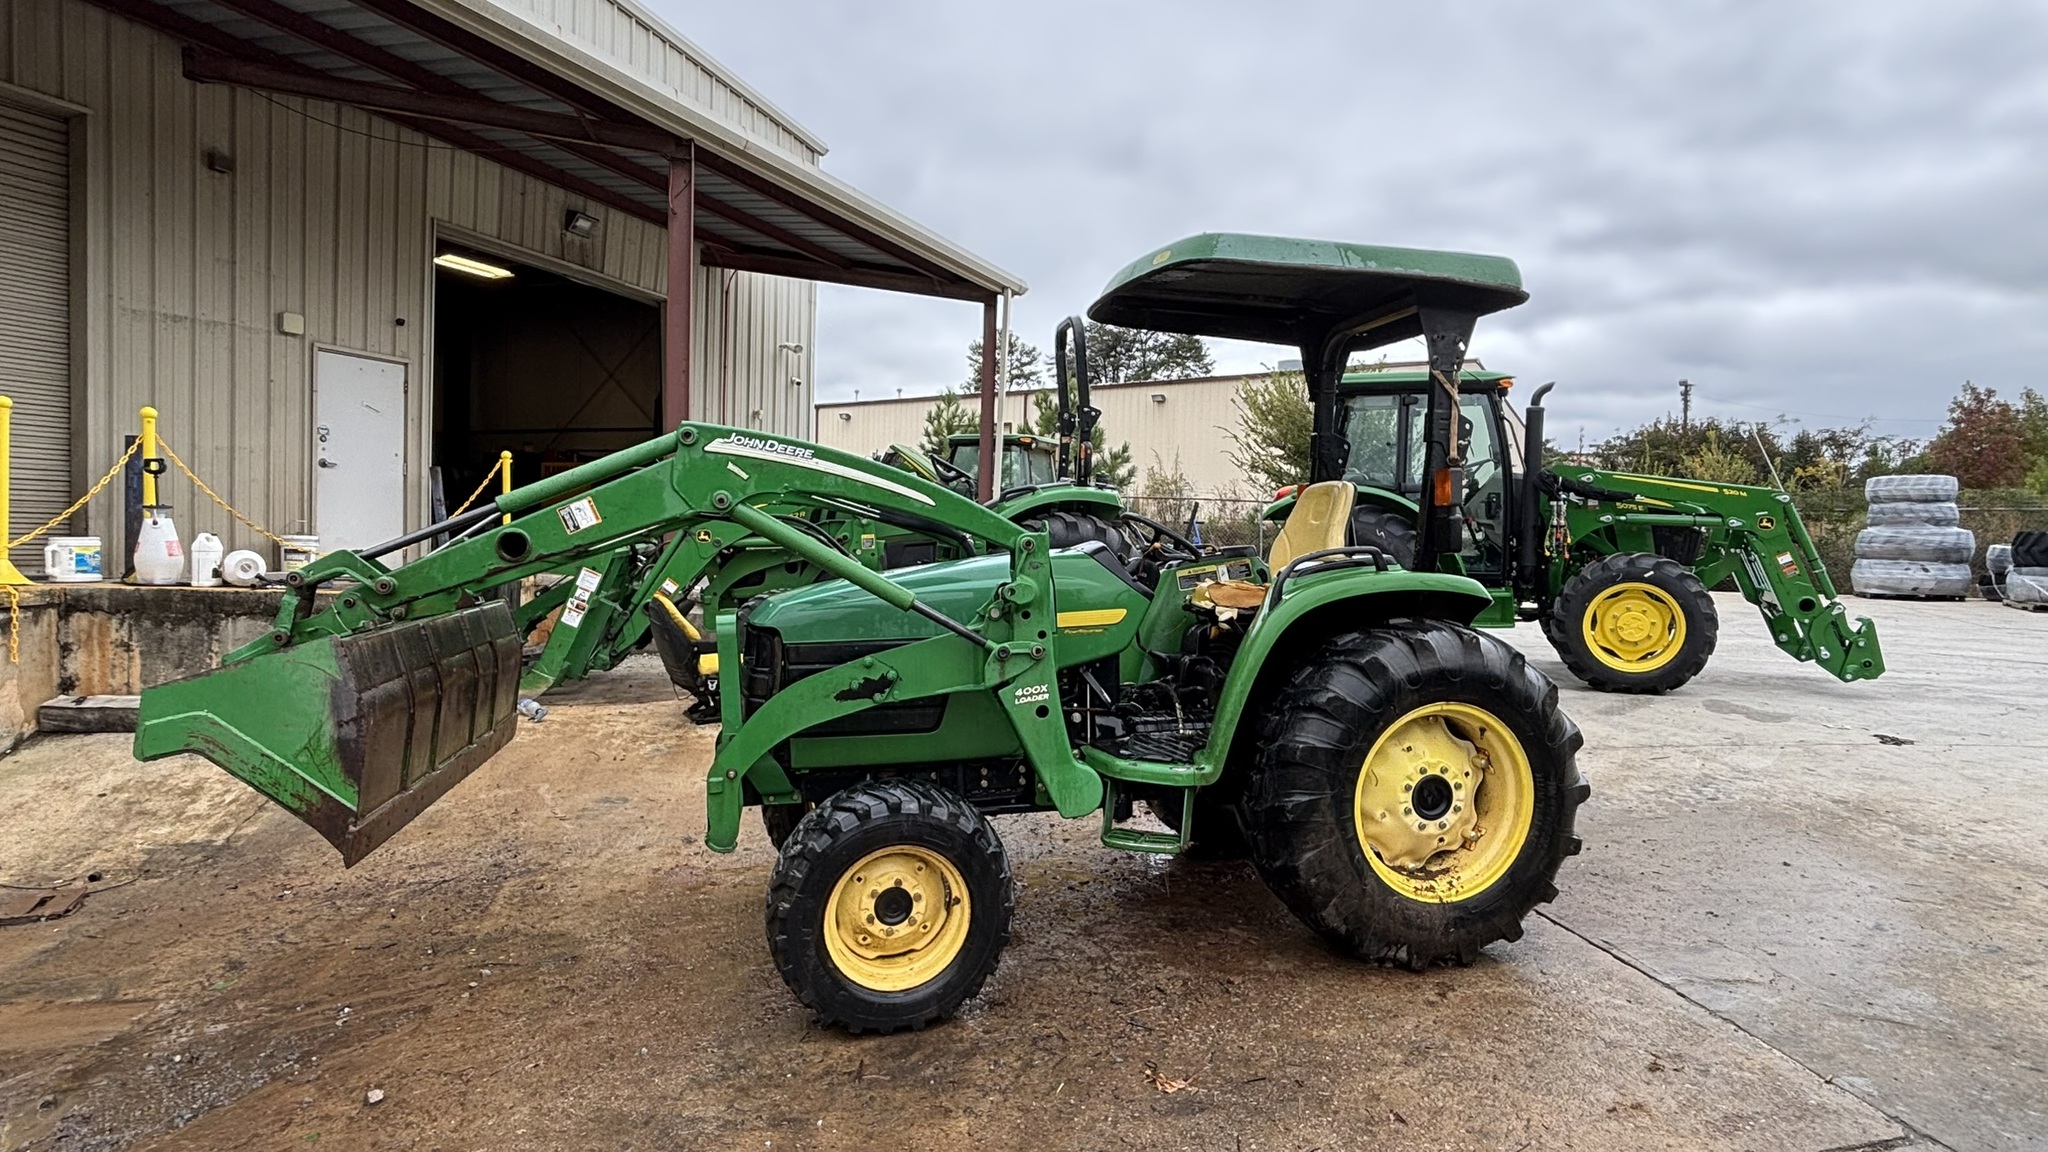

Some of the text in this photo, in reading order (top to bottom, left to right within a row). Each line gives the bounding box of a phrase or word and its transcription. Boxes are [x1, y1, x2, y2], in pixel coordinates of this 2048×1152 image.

[723, 432, 815, 459] JOHN DEERE
[1015, 683, 1049, 697] 400X
[1014, 693, 1050, 705] LOADER
